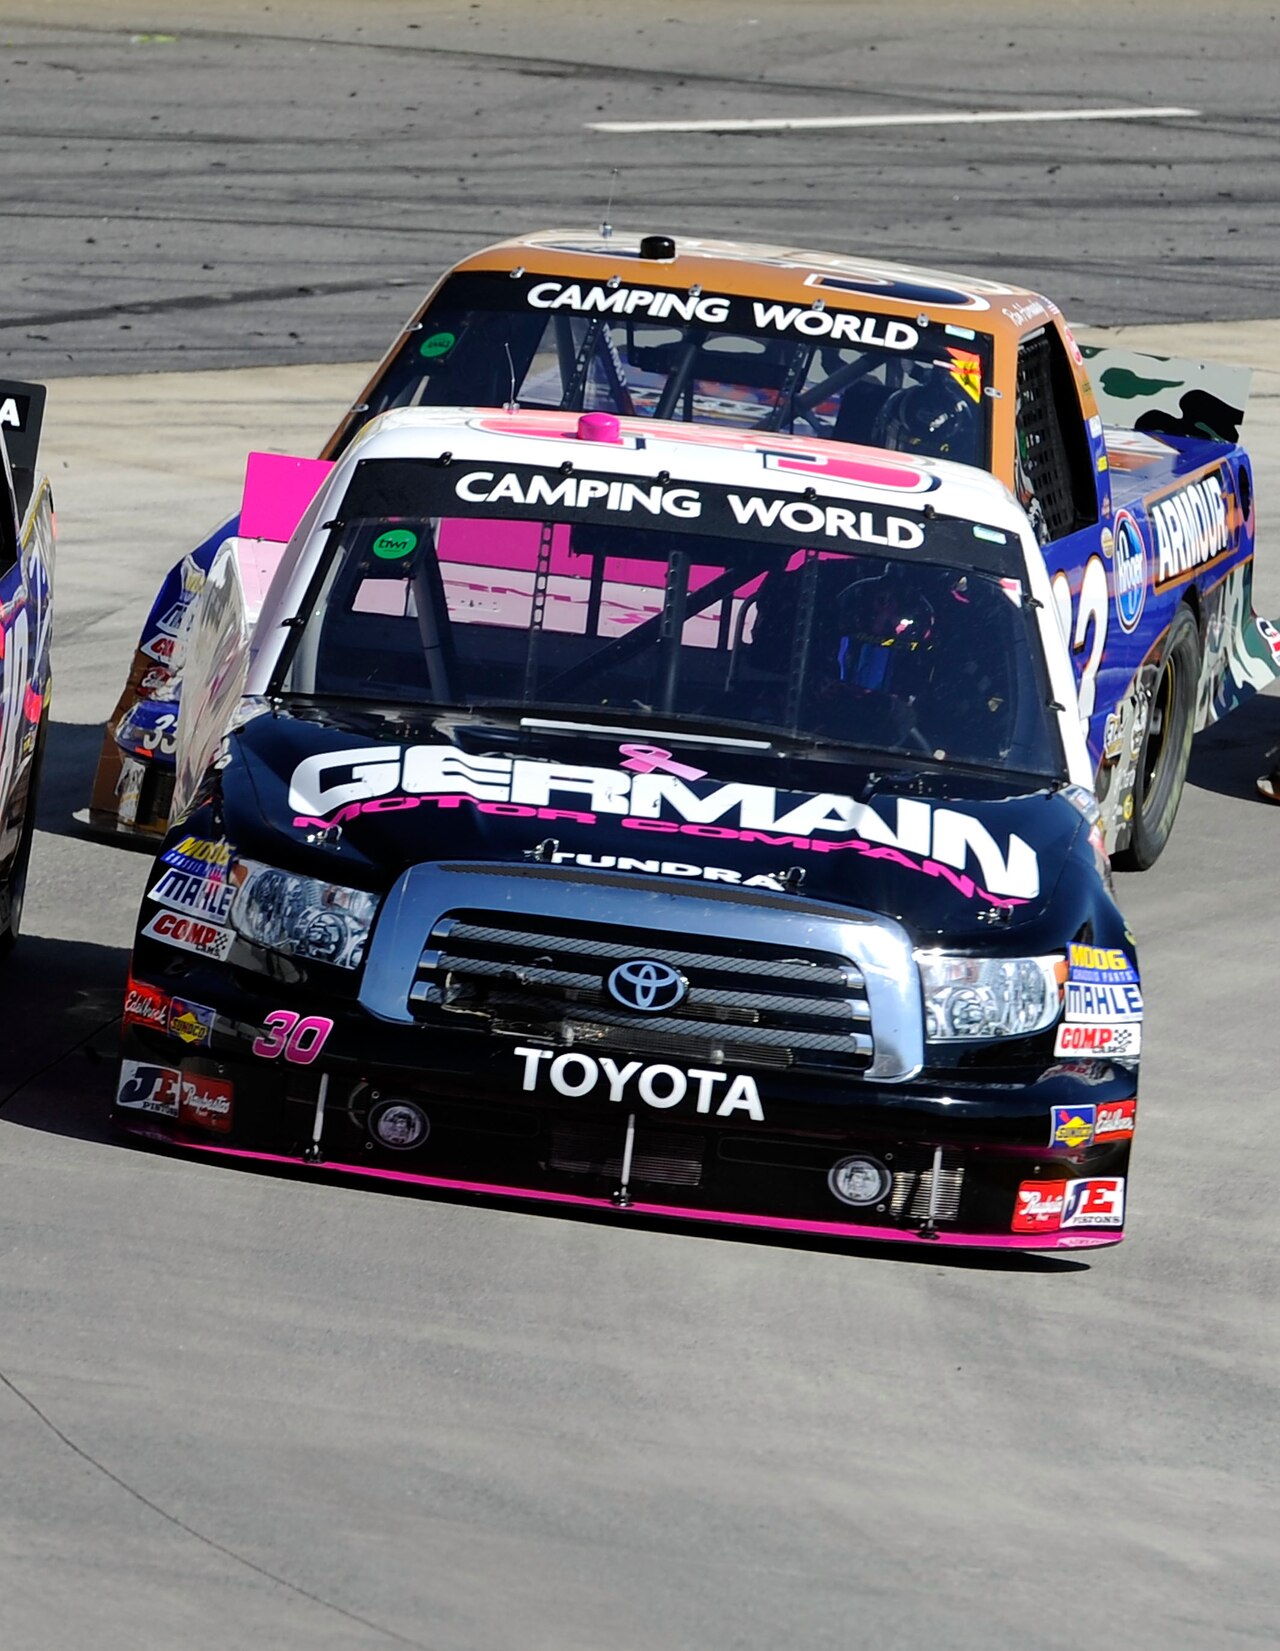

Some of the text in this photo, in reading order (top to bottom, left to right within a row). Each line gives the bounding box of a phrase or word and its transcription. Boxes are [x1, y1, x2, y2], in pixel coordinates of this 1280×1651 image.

[526, 282, 919, 350] CAMPING WORLD
[454, 471, 925, 550] CAMPING WORLD
[1151, 476, 1229, 582] ARMOUR
[287, 744, 1039, 900] GERMAIN
[292, 794, 1030, 907] MOTOR COMPANY
[550, 852, 787, 891] TUNDRA
[152, 913, 218, 947] COMP
[1069, 944, 1128, 971] MOOG
[123, 990, 167, 1026] Edelbrock
[1067, 984, 1143, 1015] MAHLE
[171, 1018, 208, 1040] SUNOCO
[251, 1009, 335, 1065] 30
[1060, 1026, 1113, 1050] COMP
[119, 1065, 179, 1106] JE
[513, 1046, 766, 1122] TOYOTA
[1063, 1180, 1119, 1224] JE
